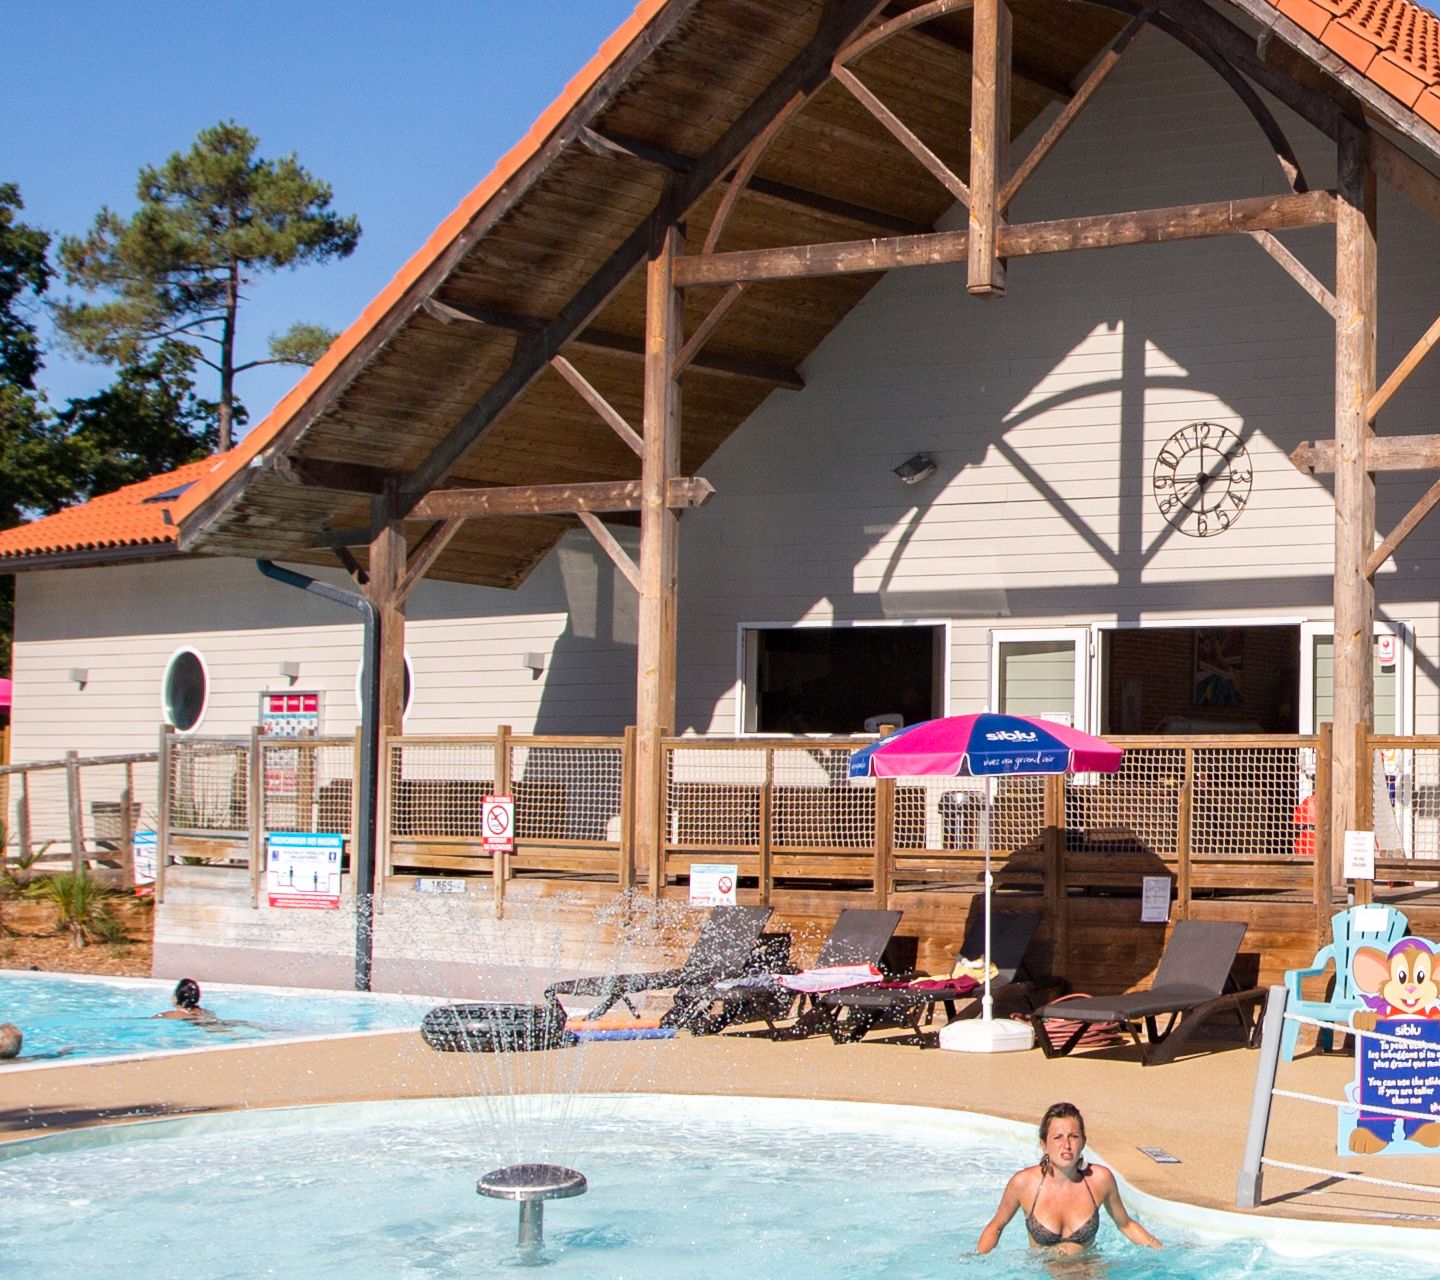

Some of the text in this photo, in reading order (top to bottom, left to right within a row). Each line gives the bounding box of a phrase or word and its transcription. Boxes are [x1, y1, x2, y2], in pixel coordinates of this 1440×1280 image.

[1193, 422, 1211, 448] 12
[986, 730, 1036, 741] siblu
[1394, 1024, 1422, 1036] siblu
